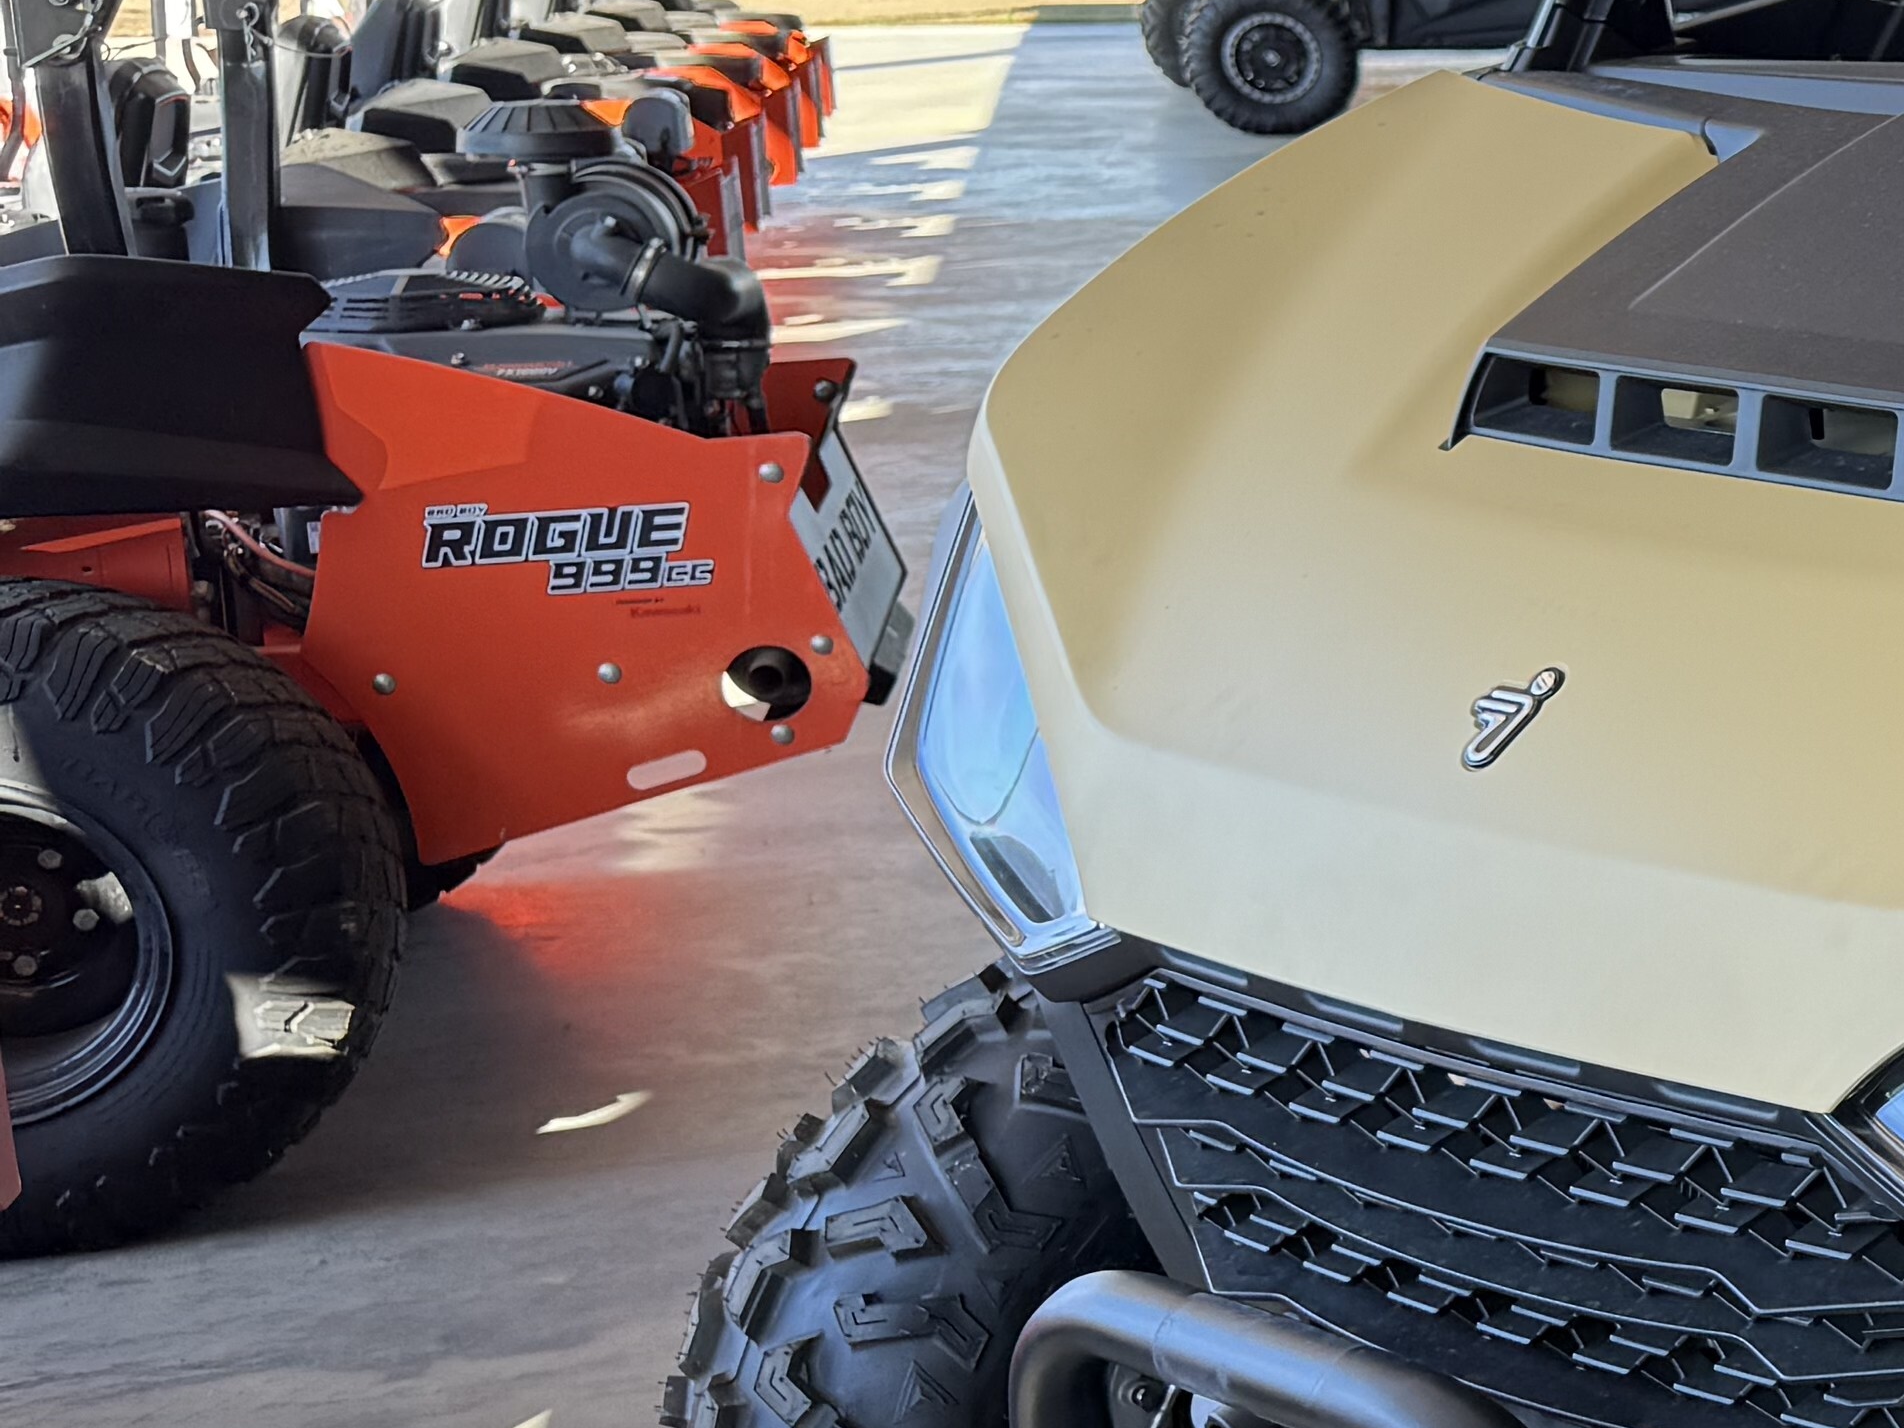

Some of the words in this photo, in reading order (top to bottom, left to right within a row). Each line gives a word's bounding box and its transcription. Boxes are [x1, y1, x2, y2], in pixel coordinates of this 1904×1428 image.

[422, 502, 690, 568] ROGUE
[814, 528, 857, 613] BAD
[838, 479, 877, 565] BOY
